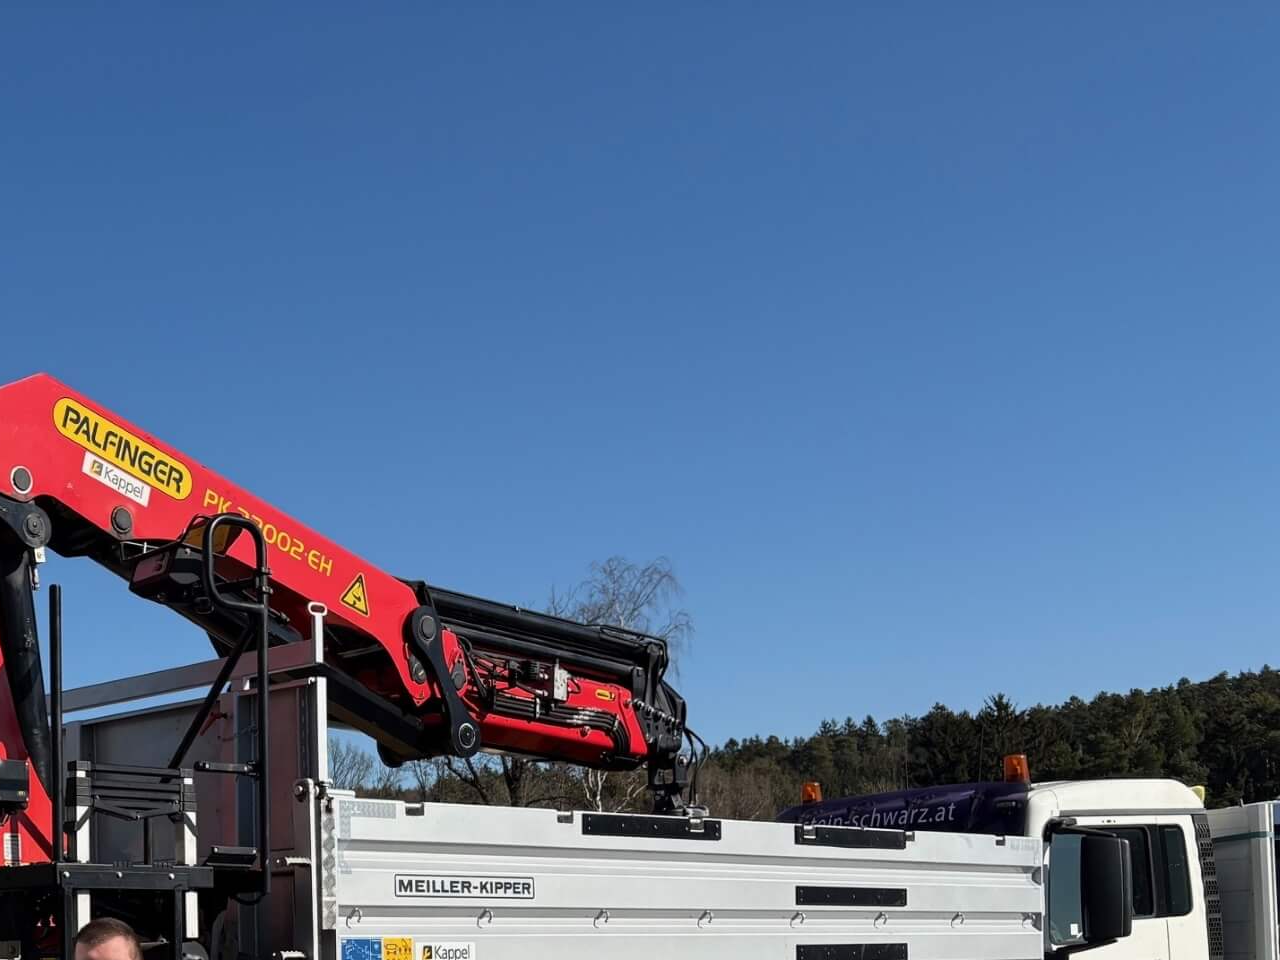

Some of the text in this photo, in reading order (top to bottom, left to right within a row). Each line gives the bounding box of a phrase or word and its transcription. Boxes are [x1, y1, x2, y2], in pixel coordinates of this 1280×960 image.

[61, 404, 184, 495] PALFINGER
[103, 465, 145, 500] Kappel
[203, 488, 232, 514] PK
[397, 878, 532, 896] MEILLER-KIPPER
